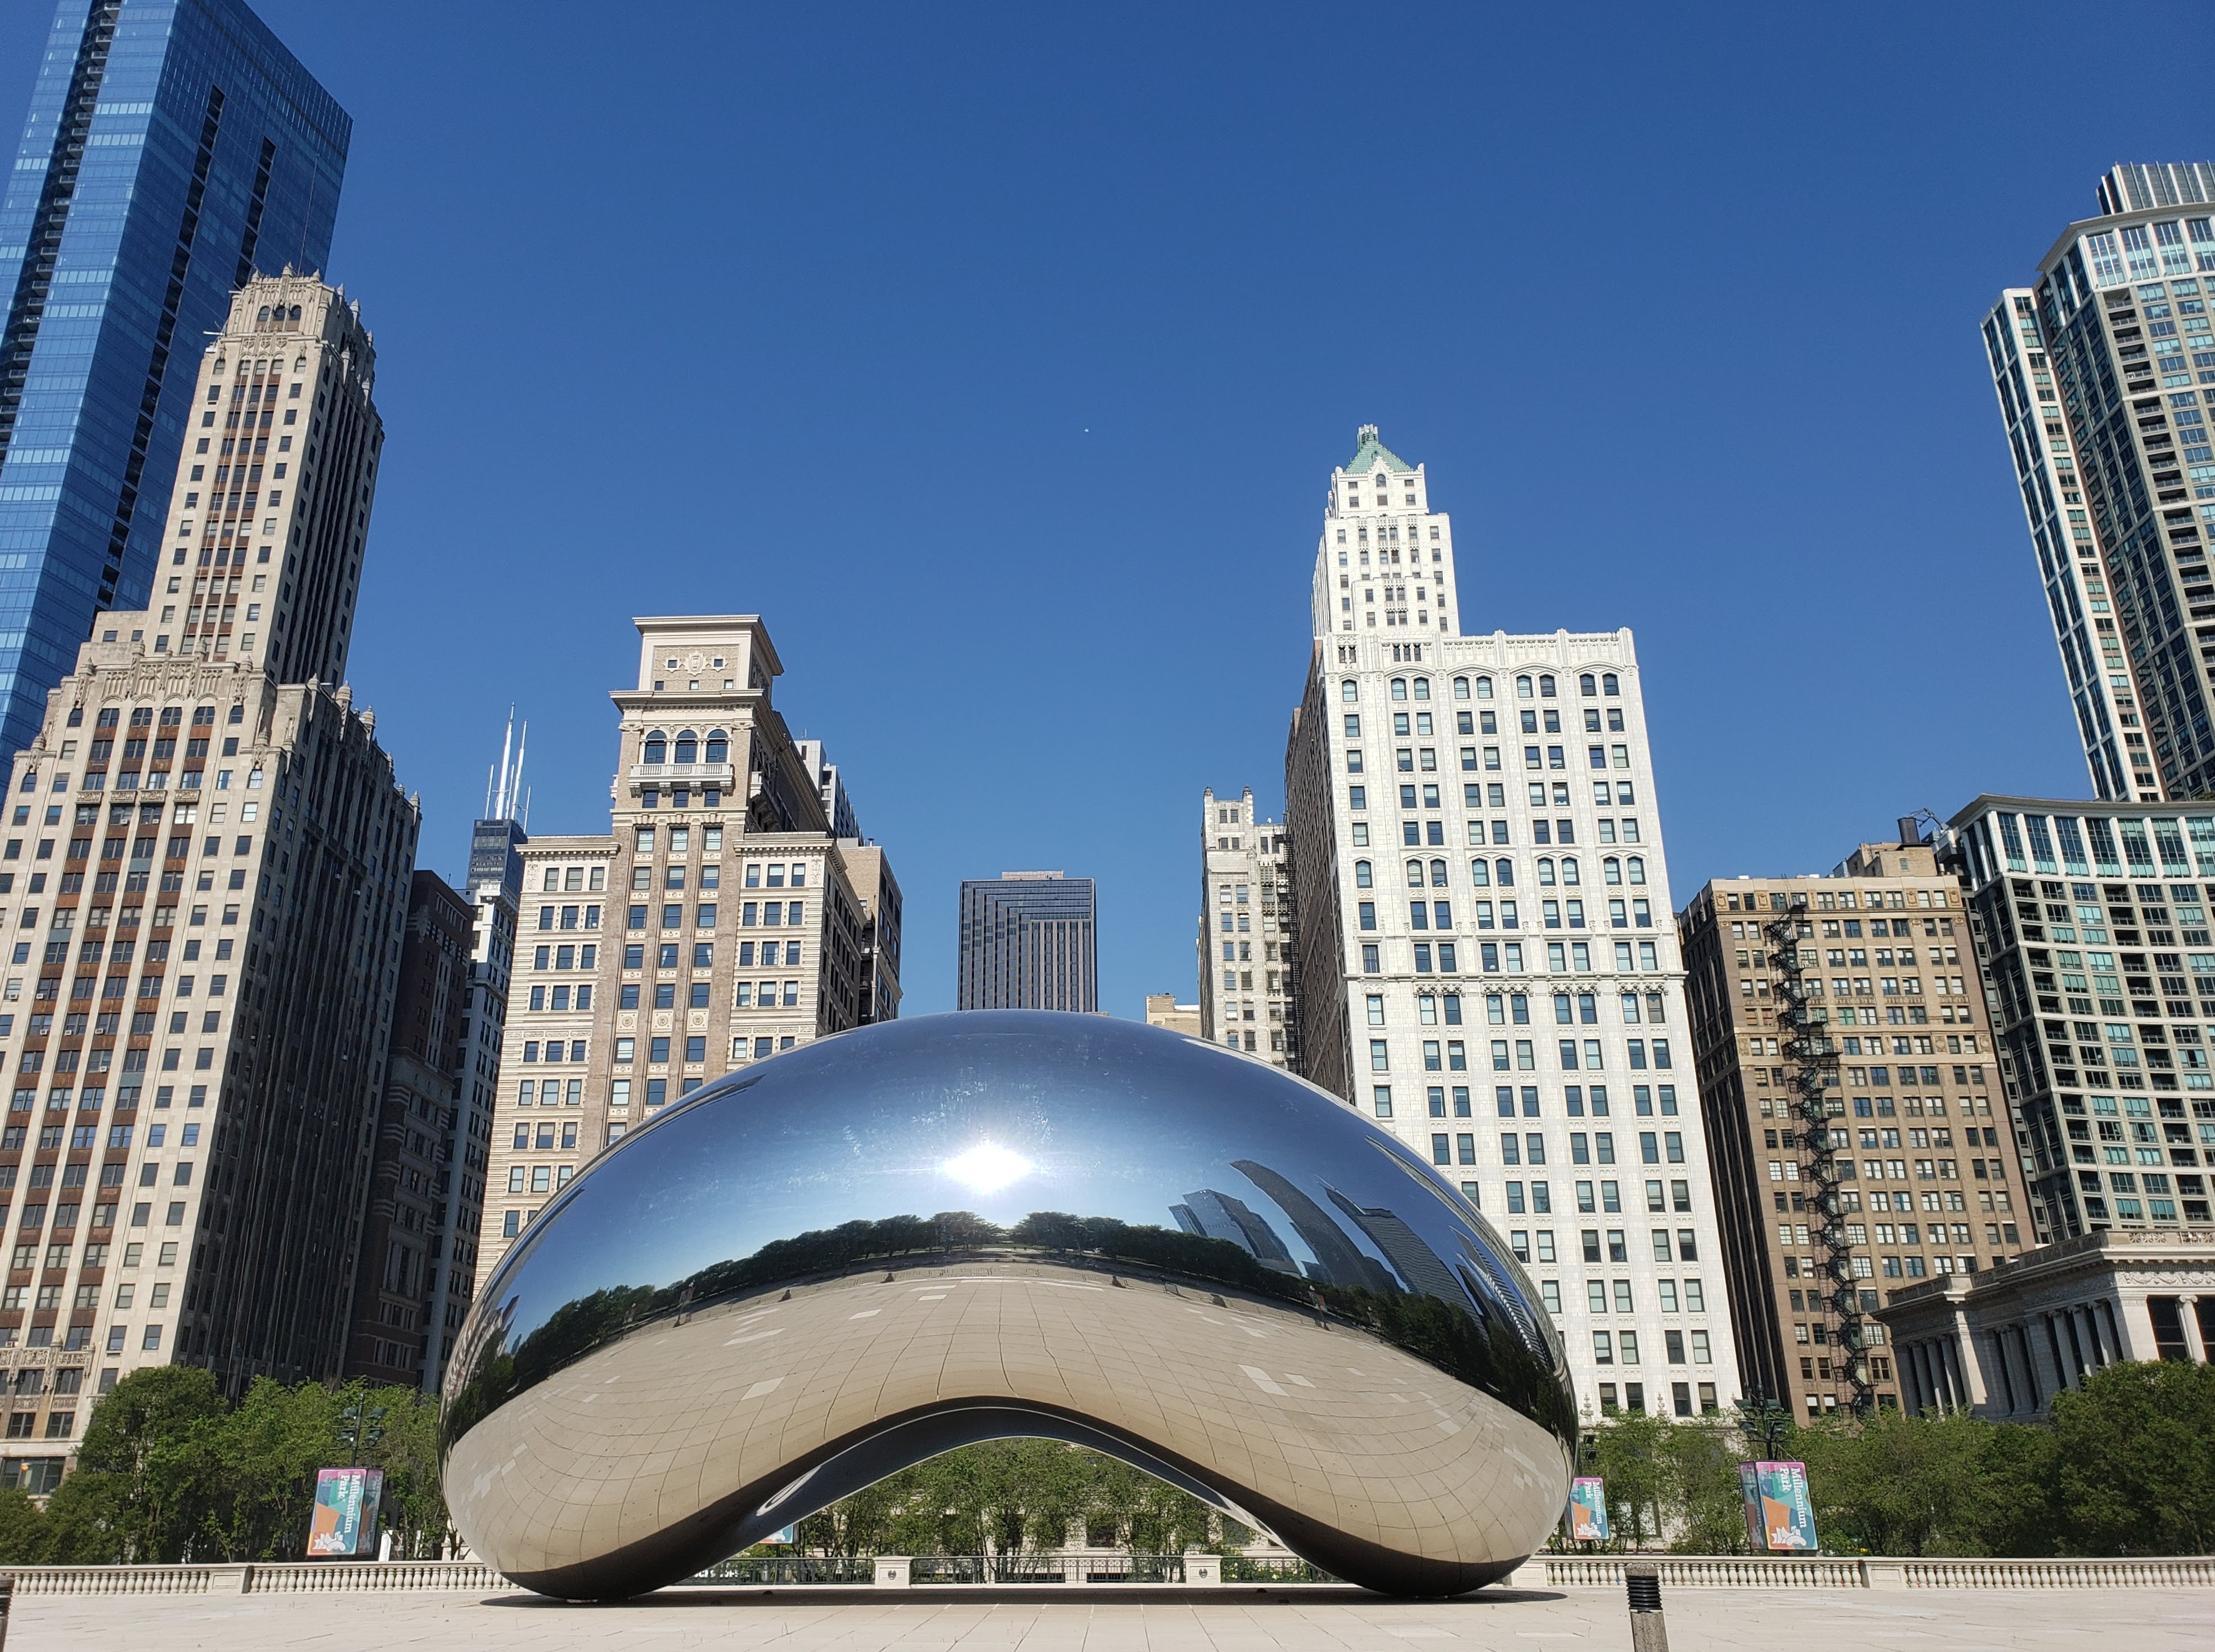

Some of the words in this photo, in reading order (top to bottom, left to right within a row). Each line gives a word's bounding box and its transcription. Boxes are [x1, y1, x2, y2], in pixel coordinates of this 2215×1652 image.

[338, 1474, 350, 1498] Park
[1585, 1482, 1593, 1498] Park
[1780, 1467, 1792, 1492] Park
[344, 1474, 361, 1534] Millennium
[1593, 1482, 1602, 1524] Millennium
[1791, 1467, 1807, 1528] Millennium
